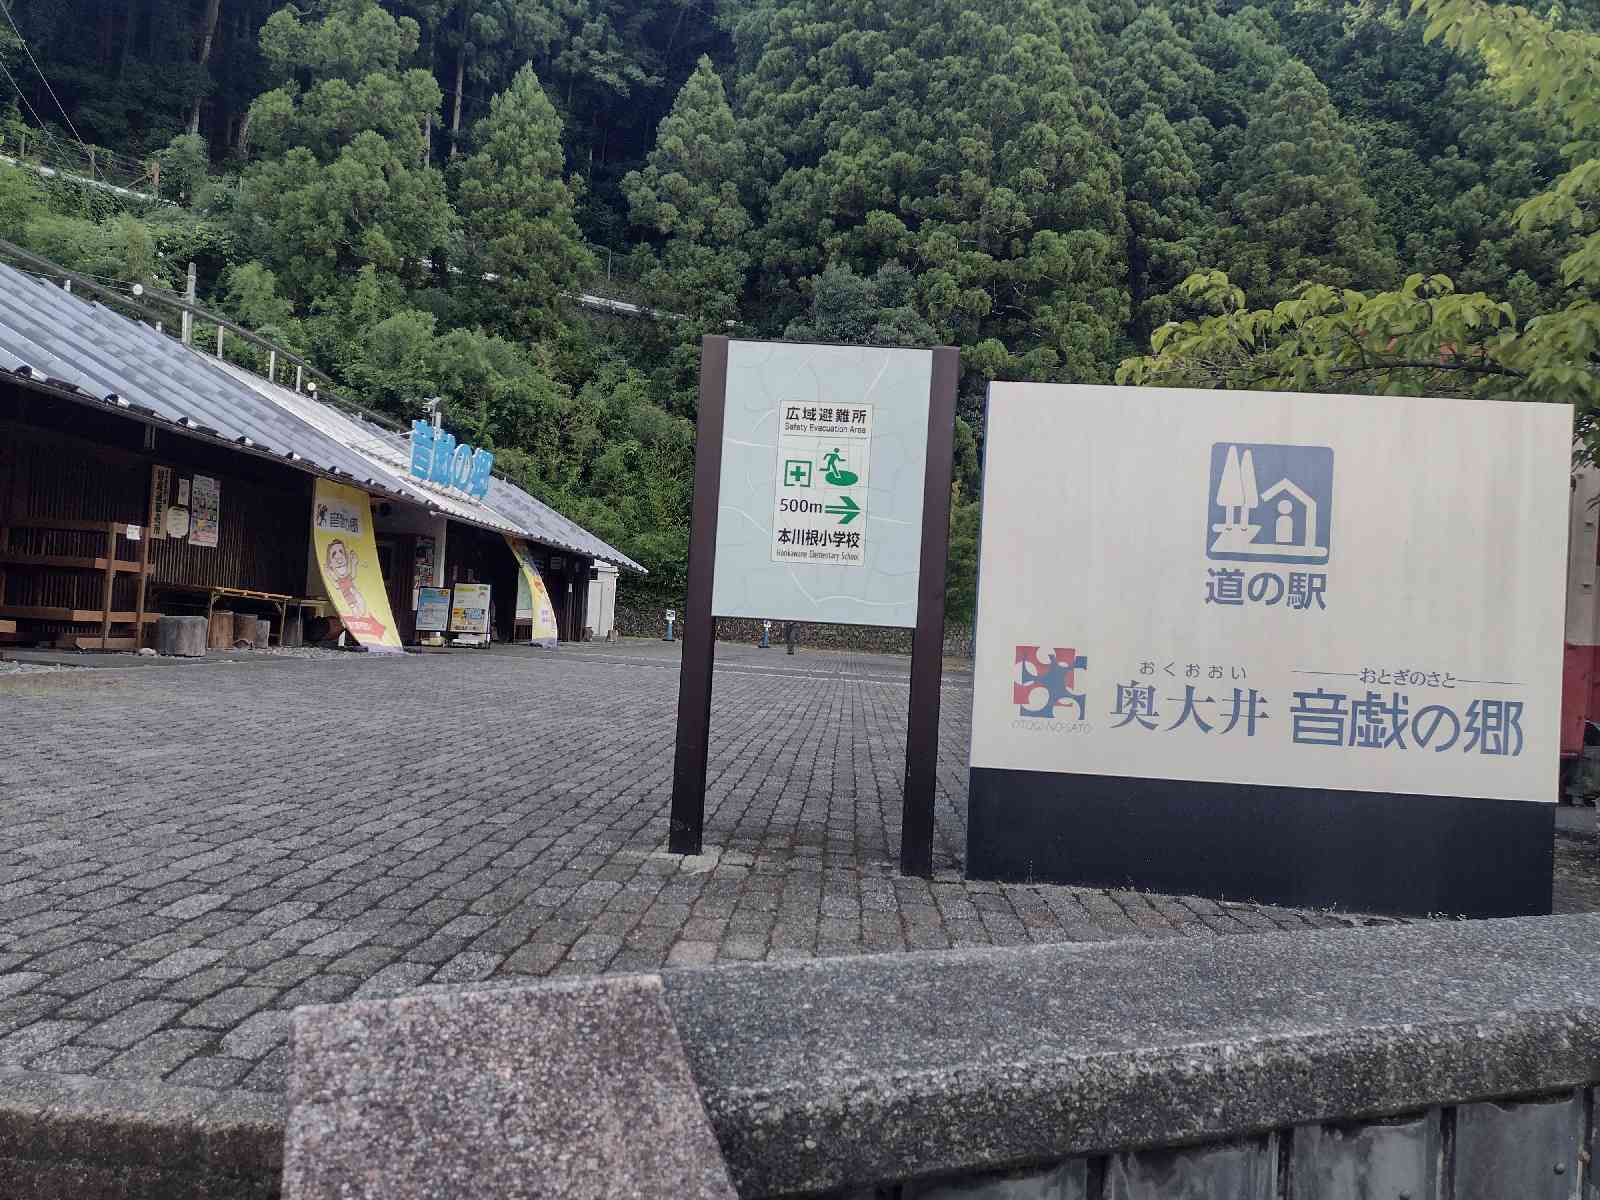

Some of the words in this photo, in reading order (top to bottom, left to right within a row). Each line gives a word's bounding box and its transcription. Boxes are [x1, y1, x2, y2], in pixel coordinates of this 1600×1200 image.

[786, 406, 867, 424] 広域避難所
[784, 422, 807, 433] Safety
[809, 423, 848, 433] Evacuation
[849, 425, 867, 434] Area
[779, 498, 823, 514] 500m
[777, 527, 861, 549] 本川根小学校
[808, 549, 840, 561] Elementary
[841, 551, 859, 561] School
[1205, 567, 1328, 610] 道の駅
[1138, 661, 1248, 681] おくおおい
[1359, 666, 1457, 689] おとぎのさと
[1109, 679, 1272, 737] 奥大井
[1289, 687, 1524, 757] 音戯の郷
